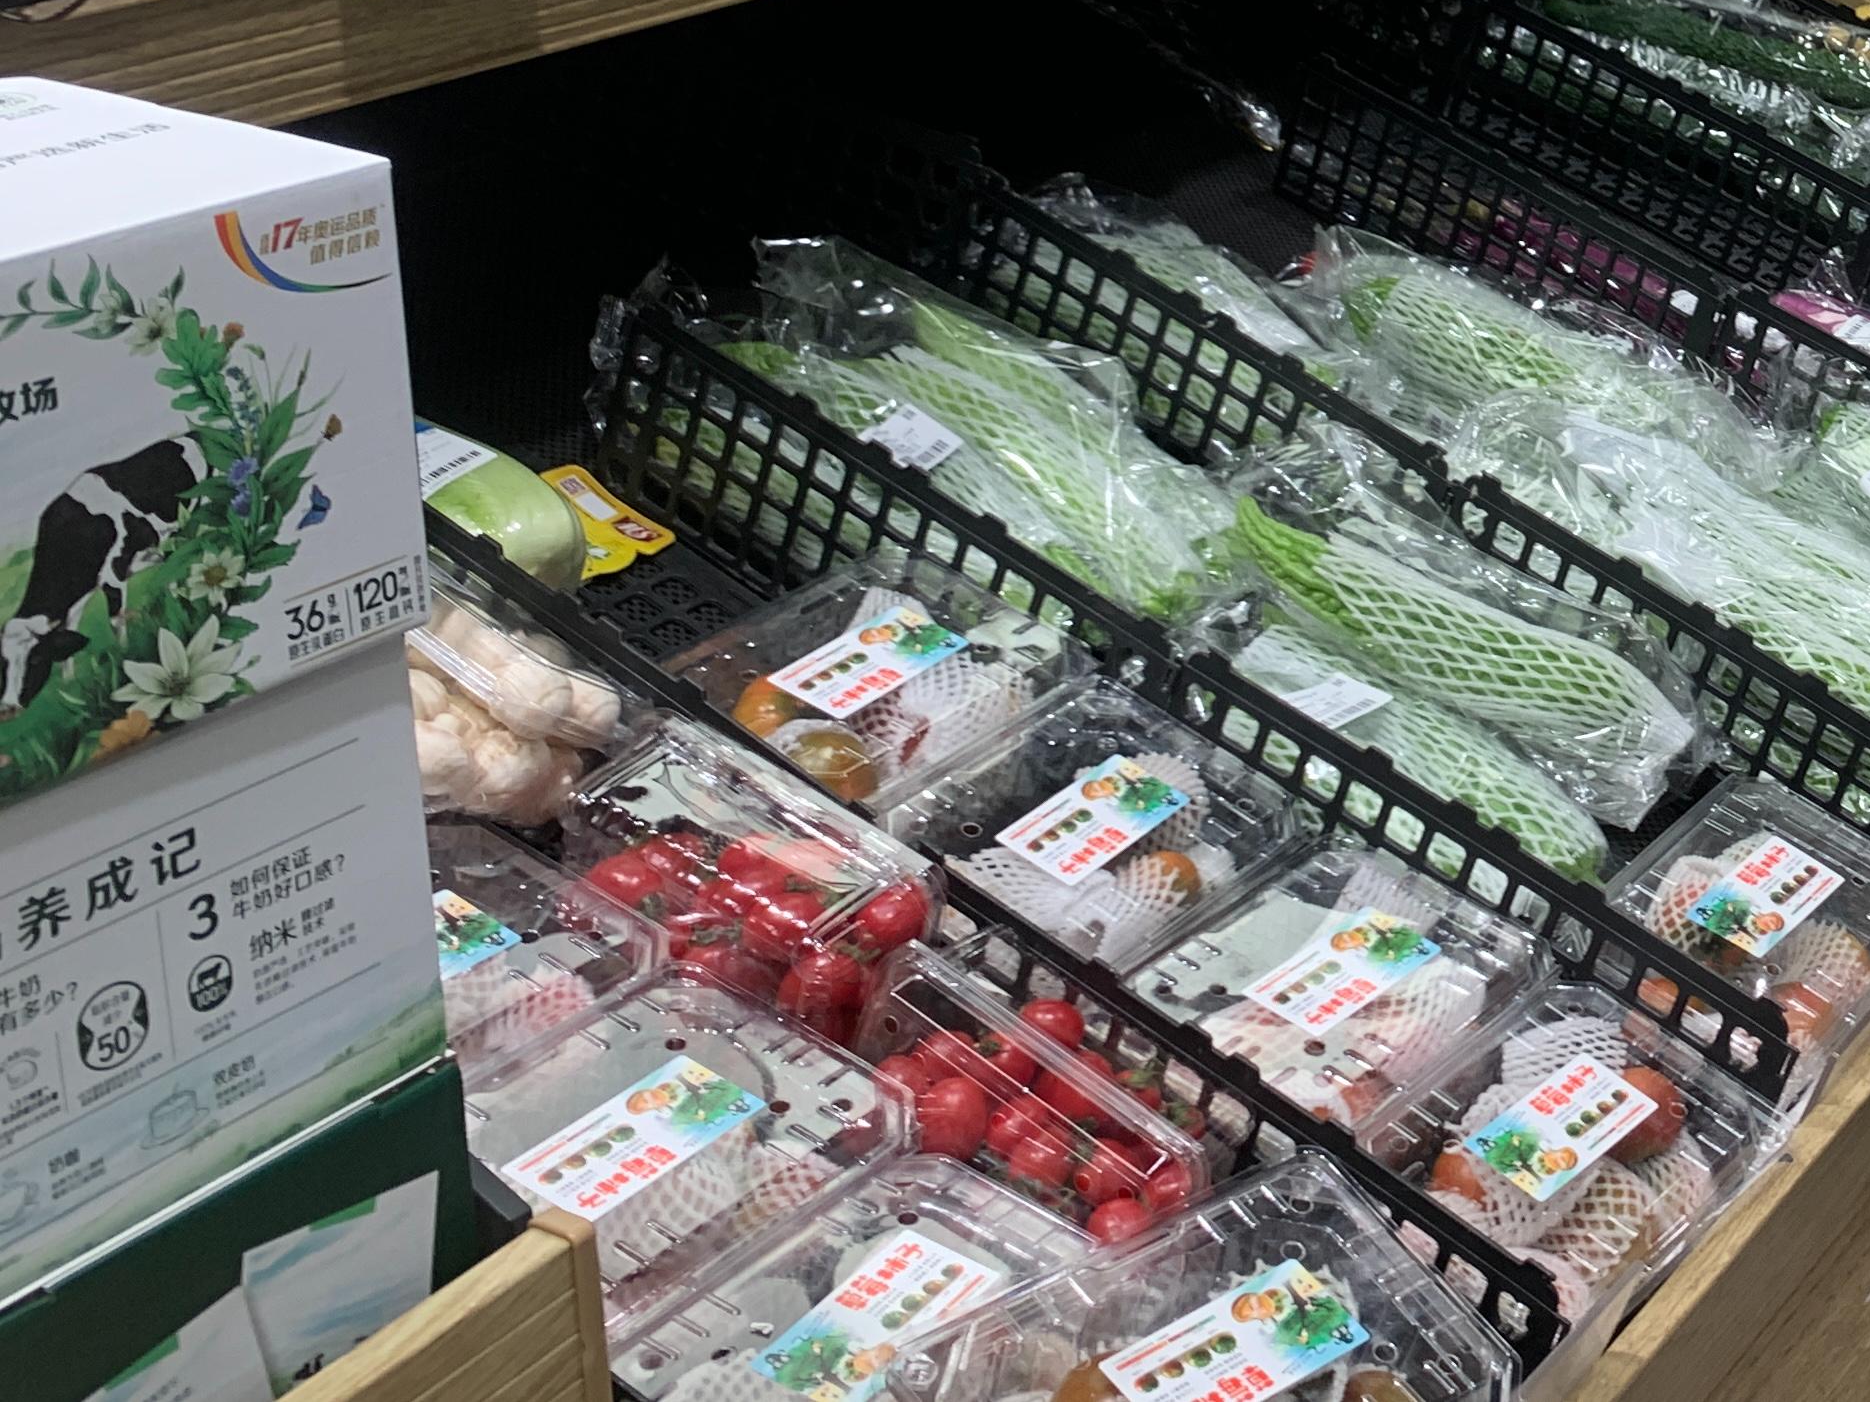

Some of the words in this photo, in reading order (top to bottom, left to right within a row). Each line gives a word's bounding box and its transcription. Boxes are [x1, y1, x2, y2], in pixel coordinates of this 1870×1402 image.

[353, 570, 398, 613] 120
[17, 826, 202, 952] 养成记
[229, 845, 314, 897] 如何保证
[187, 893, 218, 941] 3
[249, 917, 298, 962] 纳米
